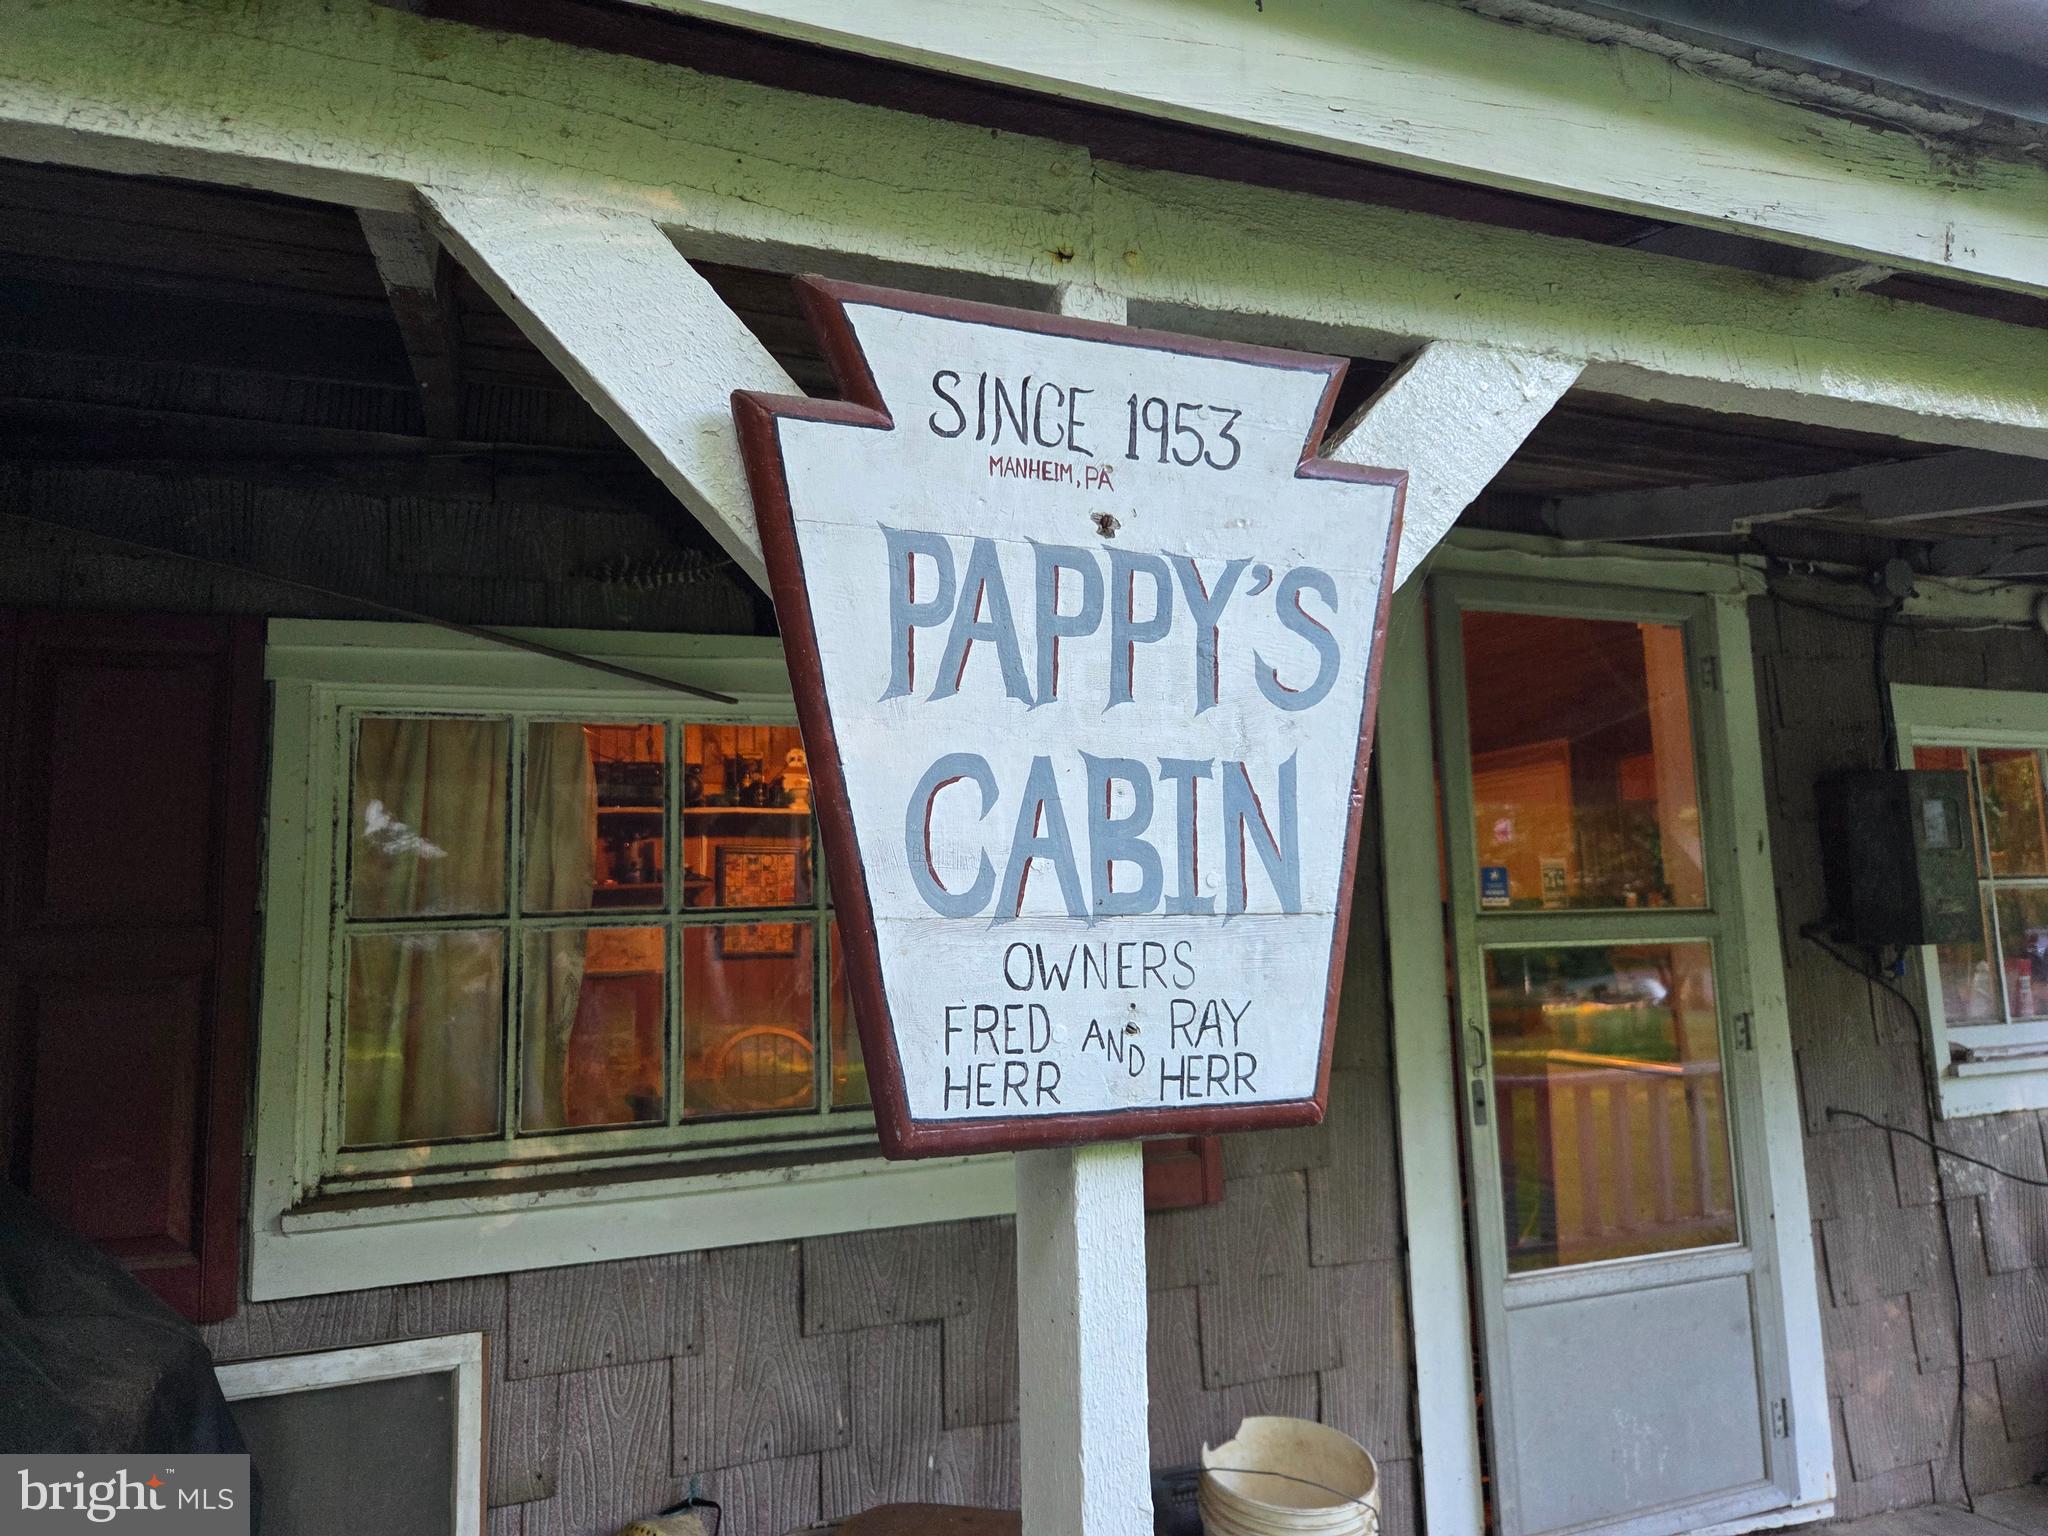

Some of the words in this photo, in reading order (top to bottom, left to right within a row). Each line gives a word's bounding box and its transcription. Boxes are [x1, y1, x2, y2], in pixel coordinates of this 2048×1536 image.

[929, 370, 1095, 457] SINCE
[1125, 393, 1242, 470] 1953
[877, 521, 1340, 716] PAPPY'S
[905, 748, 1302, 929] CABIN
[1003, 940, 1196, 991] OWNERS
[943, 1060, 1062, 1111] HERR
[1160, 1052, 1258, 1102] HERR
[944, 1003, 1052, 1056] FRED
[1081, 1019, 1146, 1078] AND
[1170, 998, 1252, 1050] RAY
